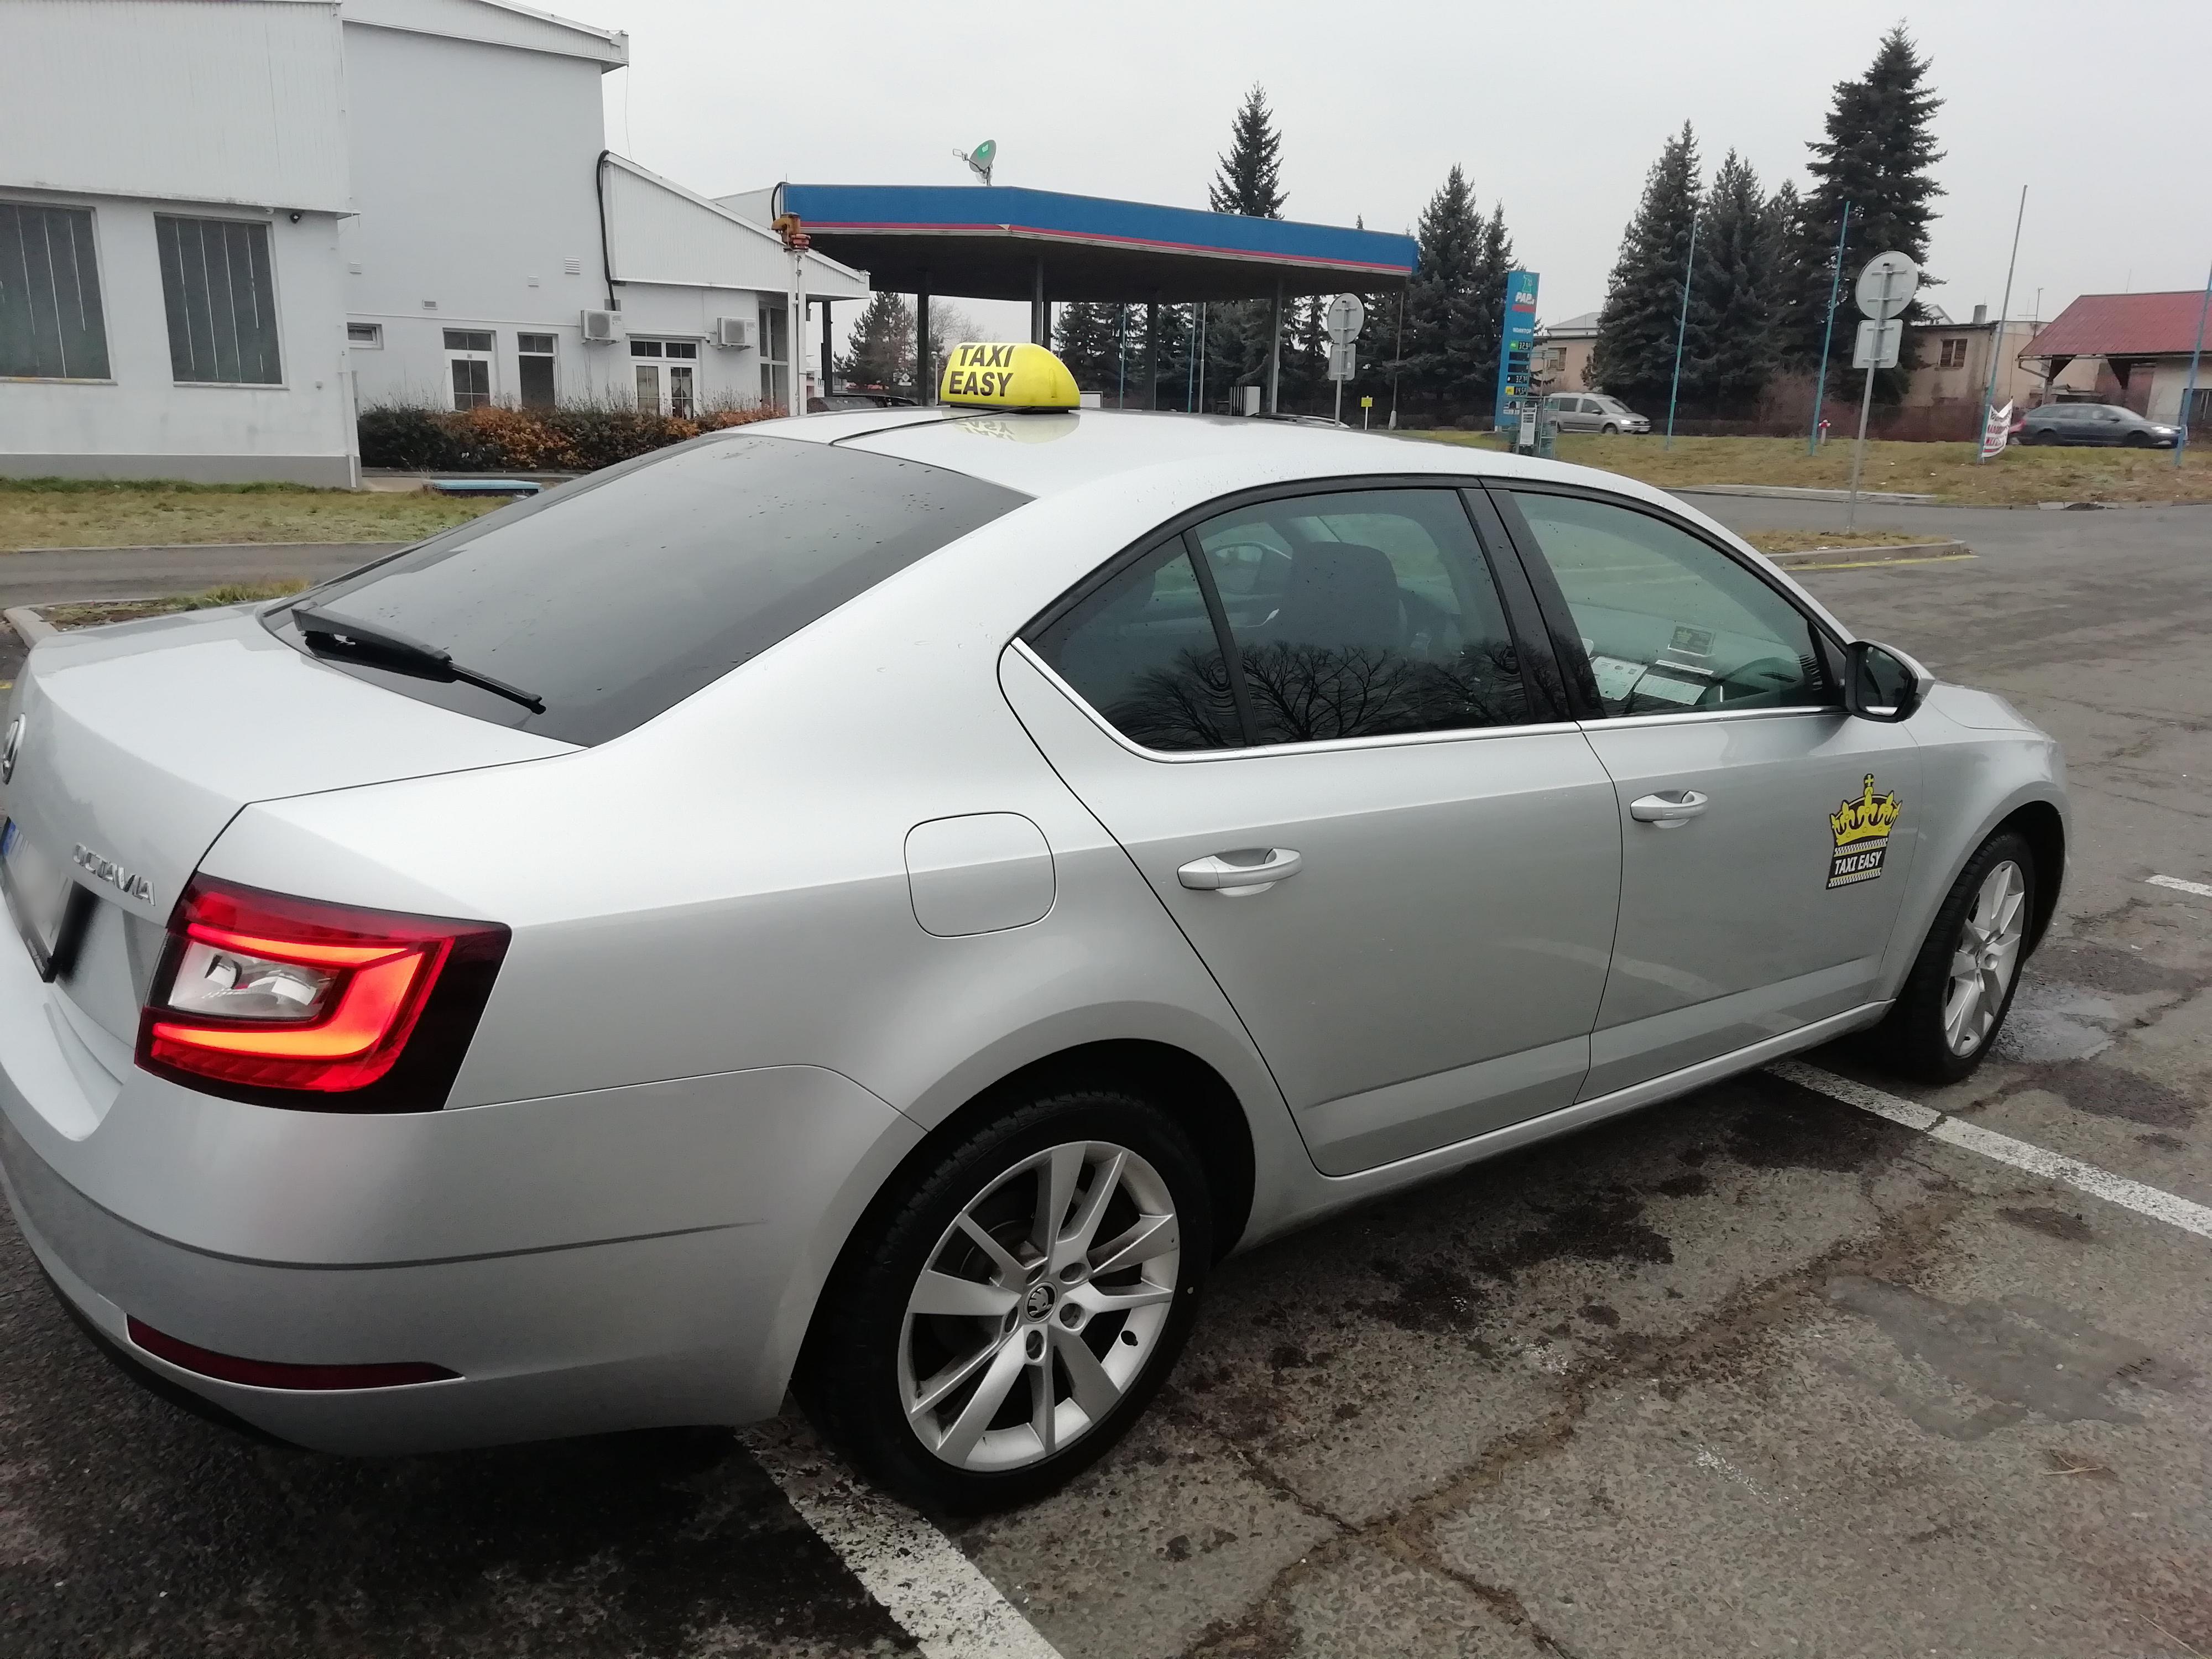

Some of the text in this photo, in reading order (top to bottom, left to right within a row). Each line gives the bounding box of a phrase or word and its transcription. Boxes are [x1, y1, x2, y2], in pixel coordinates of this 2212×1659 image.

[959, 345, 1016, 367] TAXI
[949, 371, 1014, 397] EASY
[72, 842, 156, 906] OCTAVIA
[1835, 851, 1882, 875] TAXI EASY
